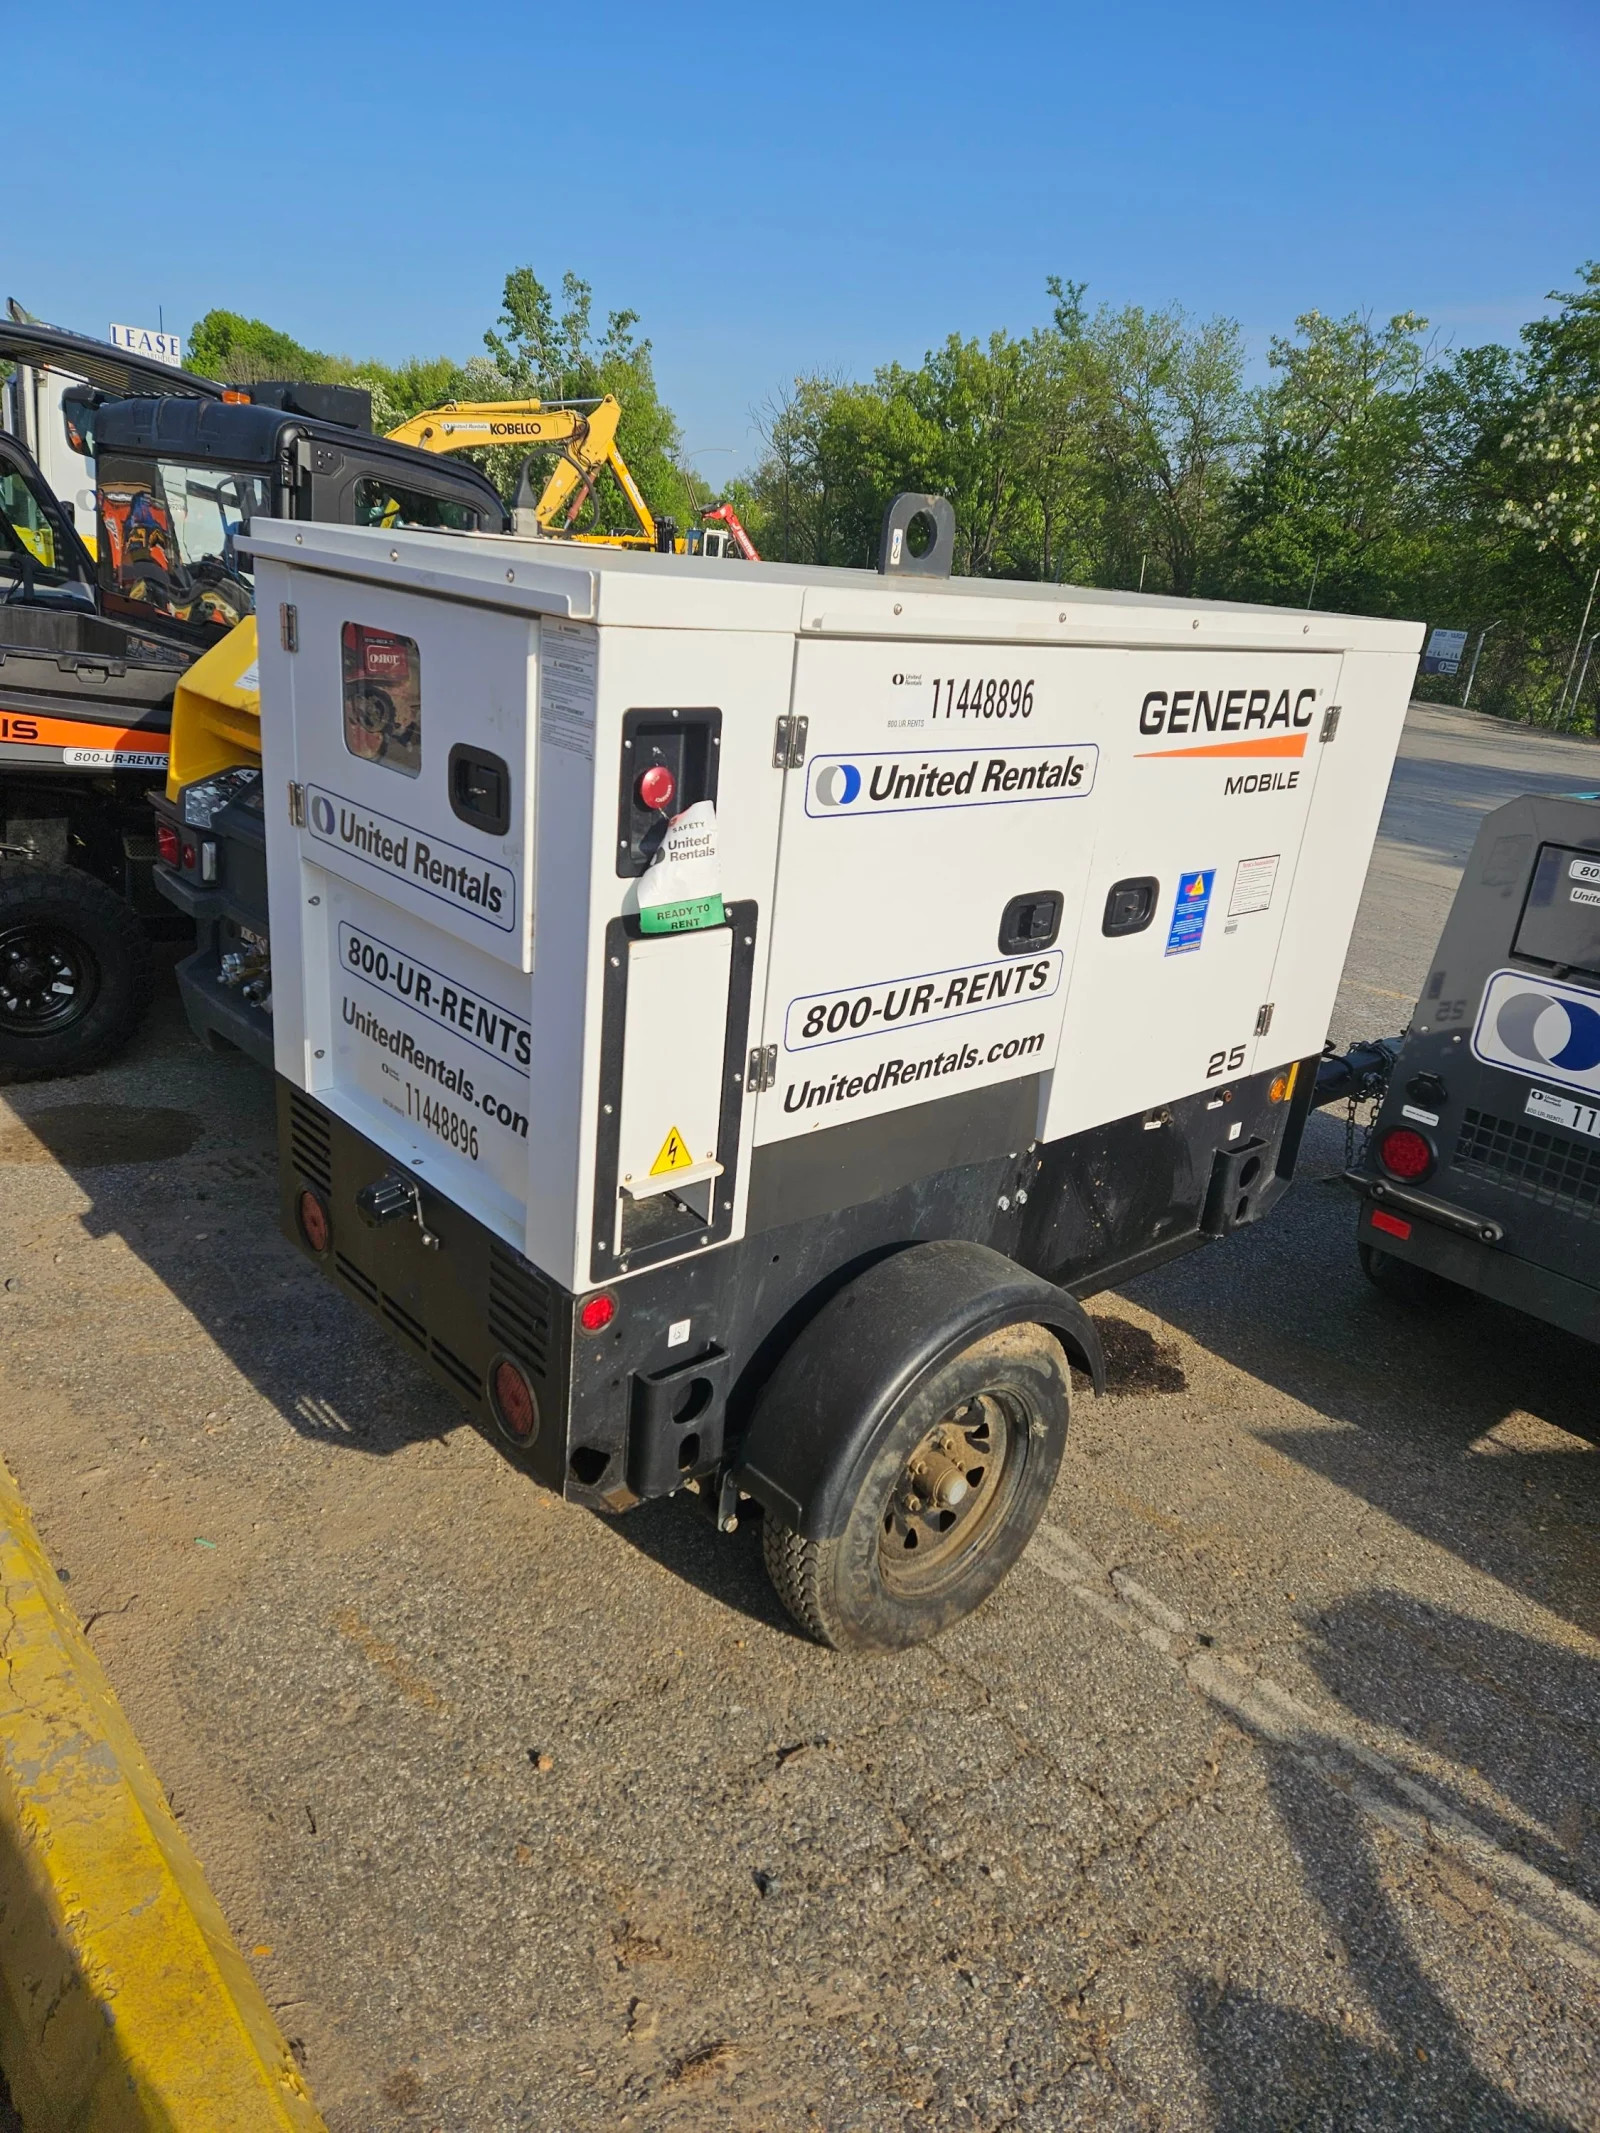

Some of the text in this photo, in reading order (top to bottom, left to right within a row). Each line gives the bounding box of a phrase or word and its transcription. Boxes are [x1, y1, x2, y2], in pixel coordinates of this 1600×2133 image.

[112, 325, 179, 357] LEASE
[490, 422, 542, 435] KOBELCO
[932, 678, 1035, 719] 11448896
[1139, 688, 1316, 735] GENERAC
[74, 751, 169, 766] 800-UR-RENTS
[869, 756, 1084, 802] United Rentals
[1224, 771, 1300, 796] MOBILE
[668, 834, 710, 850] United
[672, 821, 705, 833] SAFETY
[340, 808, 502, 913] United Rentals
[670, 847, 715, 862] Rentals
[657, 903, 710, 921] READY TO
[671, 917, 700, 930] RENT
[348, 937, 531, 1065] 800-UR-RENTS
[802, 960, 1050, 1038] 800-UR-RENTS
[783, 1032, 1045, 1114] UnitedRentals.com
[1206, 1044, 1247, 1079] 25
[406, 1082, 479, 1161] 11448896
[1572, 1105, 1600, 1133] 11
